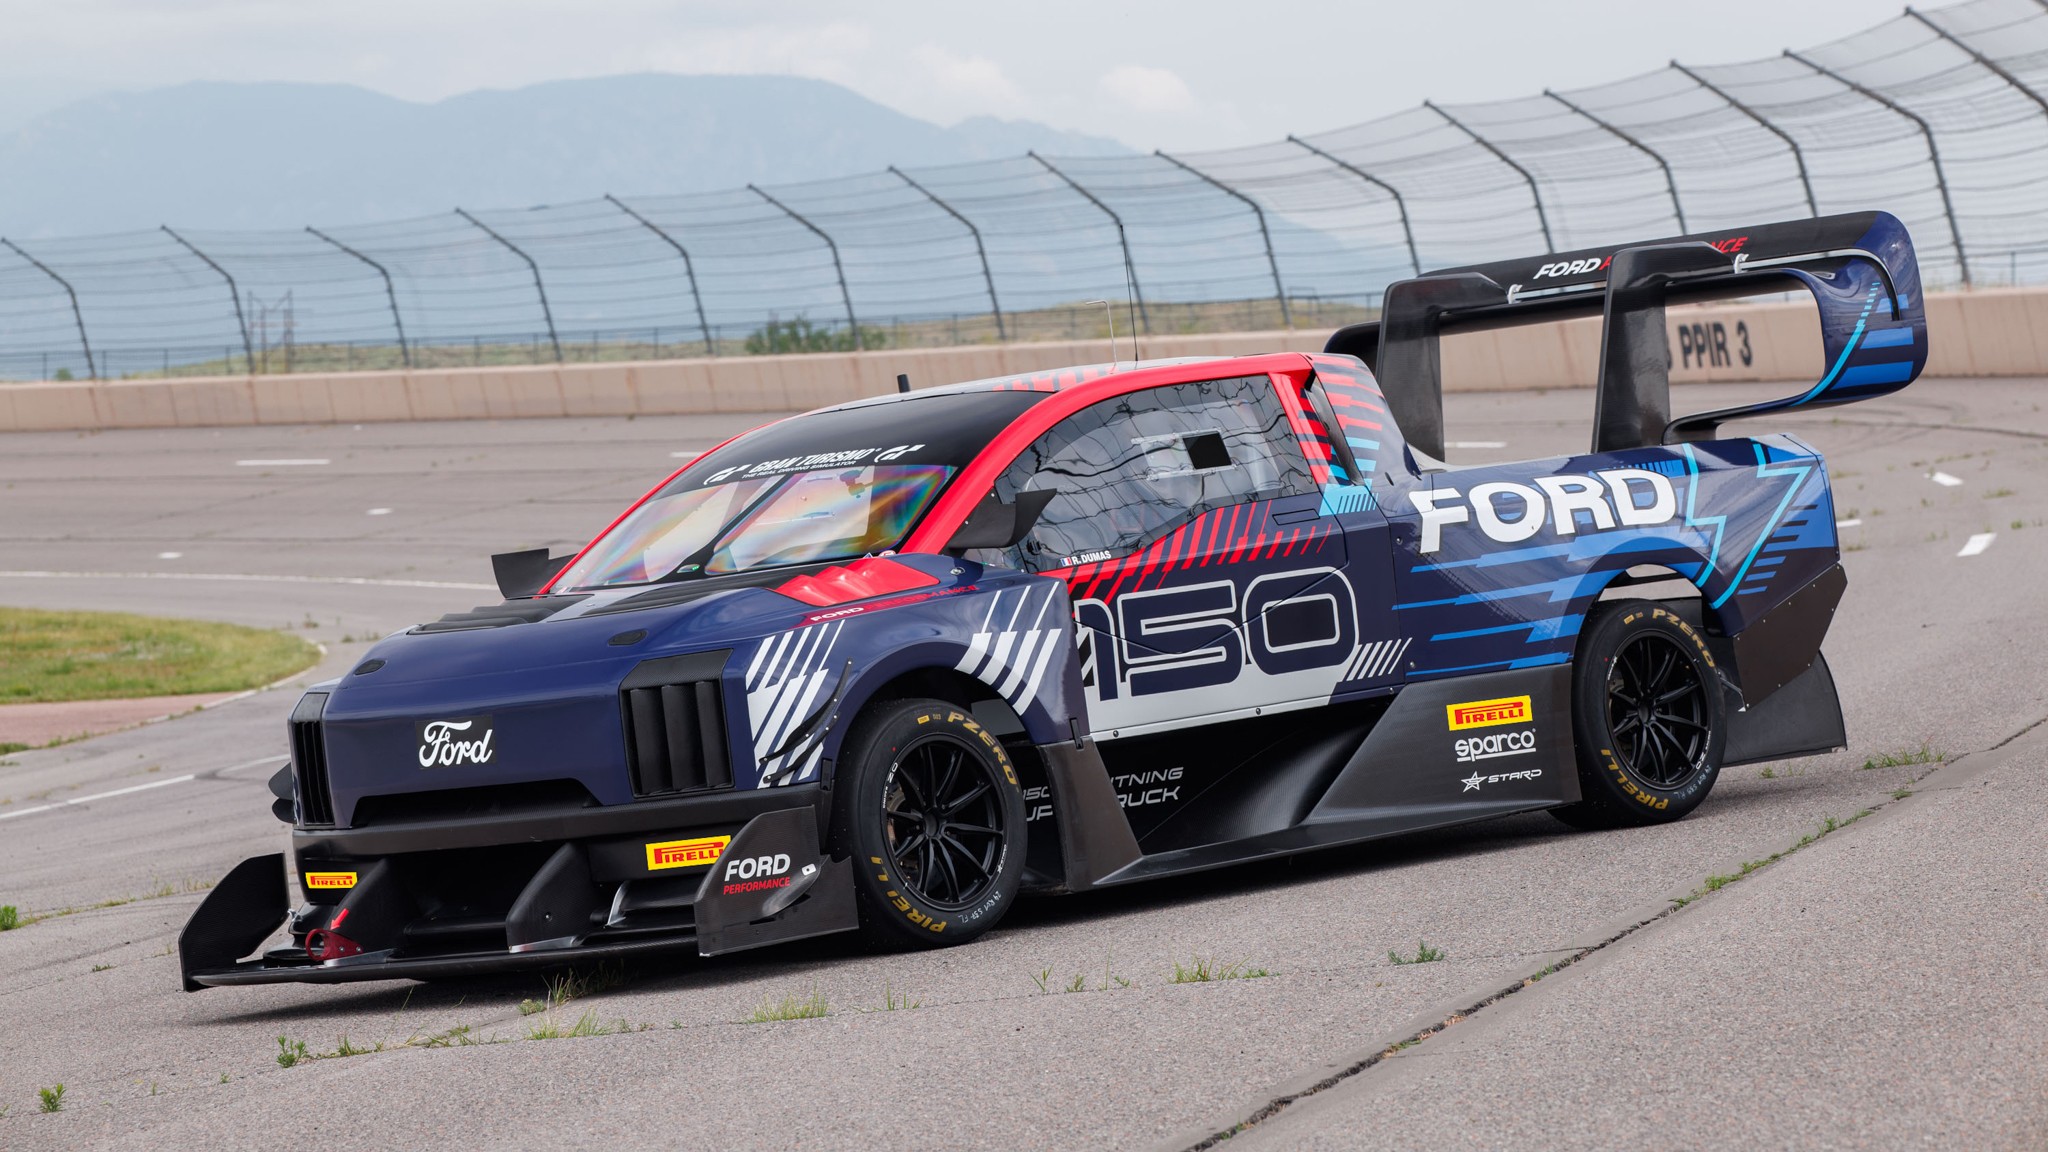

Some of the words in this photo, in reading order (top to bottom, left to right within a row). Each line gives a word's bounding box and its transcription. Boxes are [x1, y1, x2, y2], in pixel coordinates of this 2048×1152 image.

[1533, 257, 1601, 280] FORD
[1677, 321, 1732, 369] PPIR
[1736, 319, 1754, 367] 3
[748, 456, 803, 474] GRAN
[799, 448, 876, 467] TURISMO
[757, 468, 777, 477] REAL
[777, 464, 810, 473] DRIVING
[809, 460, 857, 471] SIMULATOR
[1408, 468, 1677, 554] FORD
[1081, 550, 1112, 564] DUMAS
[810, 607, 865, 623] FORD
[1074, 566, 1360, 701] 150
[1652, 608, 1716, 668] PZERO
[1454, 701, 1524, 725] PIRELLI
[418, 720, 494, 768] Ford
[947, 710, 1018, 785] PZERO
[1455, 731, 1536, 762] sparco
[1487, 768, 1542, 784] STARD
[1601, 749, 1670, 810] PIRELLI
[309, 875, 353, 886] PIRELLI
[724, 853, 792, 882] FORD
[723, 876, 791, 896] PERFORMANCE
